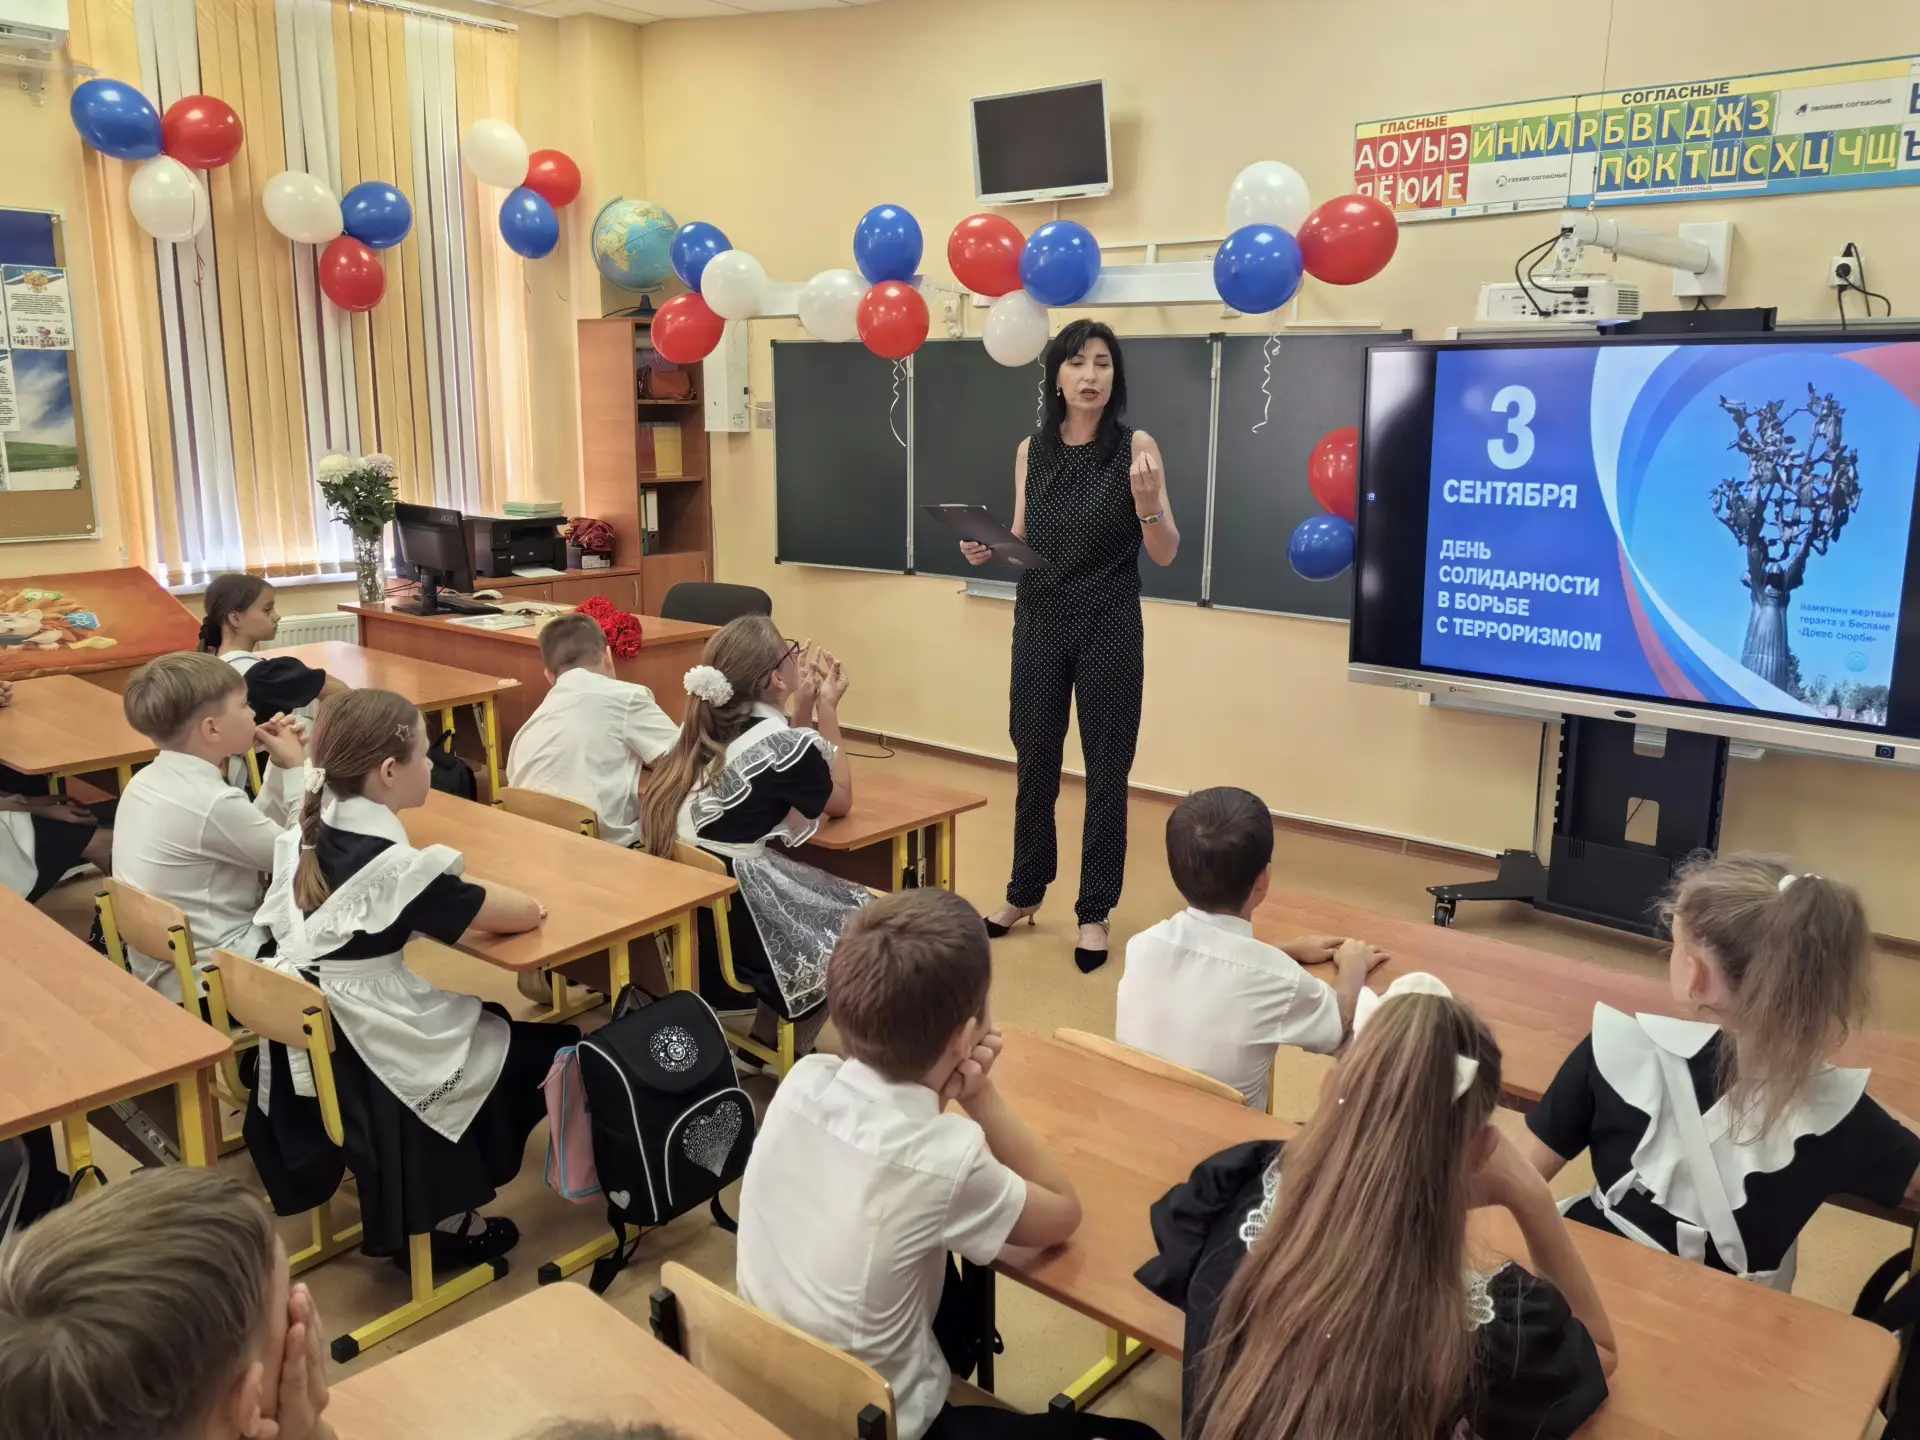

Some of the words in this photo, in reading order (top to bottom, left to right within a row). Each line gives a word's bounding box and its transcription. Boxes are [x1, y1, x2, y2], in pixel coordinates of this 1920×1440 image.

[1621, 81, 1730, 105] СОГЛАСНЫЕ
[1810, 103, 1843, 112] ЗВОНКИЕ
[1845, 98, 1892, 108] СОГЛАСНЫЕ
[1379, 115, 1448, 135] ГЛАСНЫЕ
[1507, 175, 1530, 184] ГЛУХИЕ
[1531, 172, 1568, 182] СОГЛАСНЫЕ
[1644, 188, 1671, 196] ПАРНЫЕ
[1672, 185, 1713, 194] СОГЛАСНЫЕ
[1487, 385, 1536, 470] 3
[1443, 479, 1578, 509] СЕНТЯБРЯ
[1440, 539, 1491, 560] ДЕНЬ
[1439, 565, 1600, 596] СОЛИДАРНОСТИ
[1438, 591, 1450, 608] В
[1455, 592, 1530, 616] БОРЬБЕ
[1850, 608, 1895, 619] жертвам
[1436, 616, 1449, 634] С
[1453, 617, 1602, 651] ТЕРРОРИЗМОМ
[1848, 619, 1891, 631] Беслане
